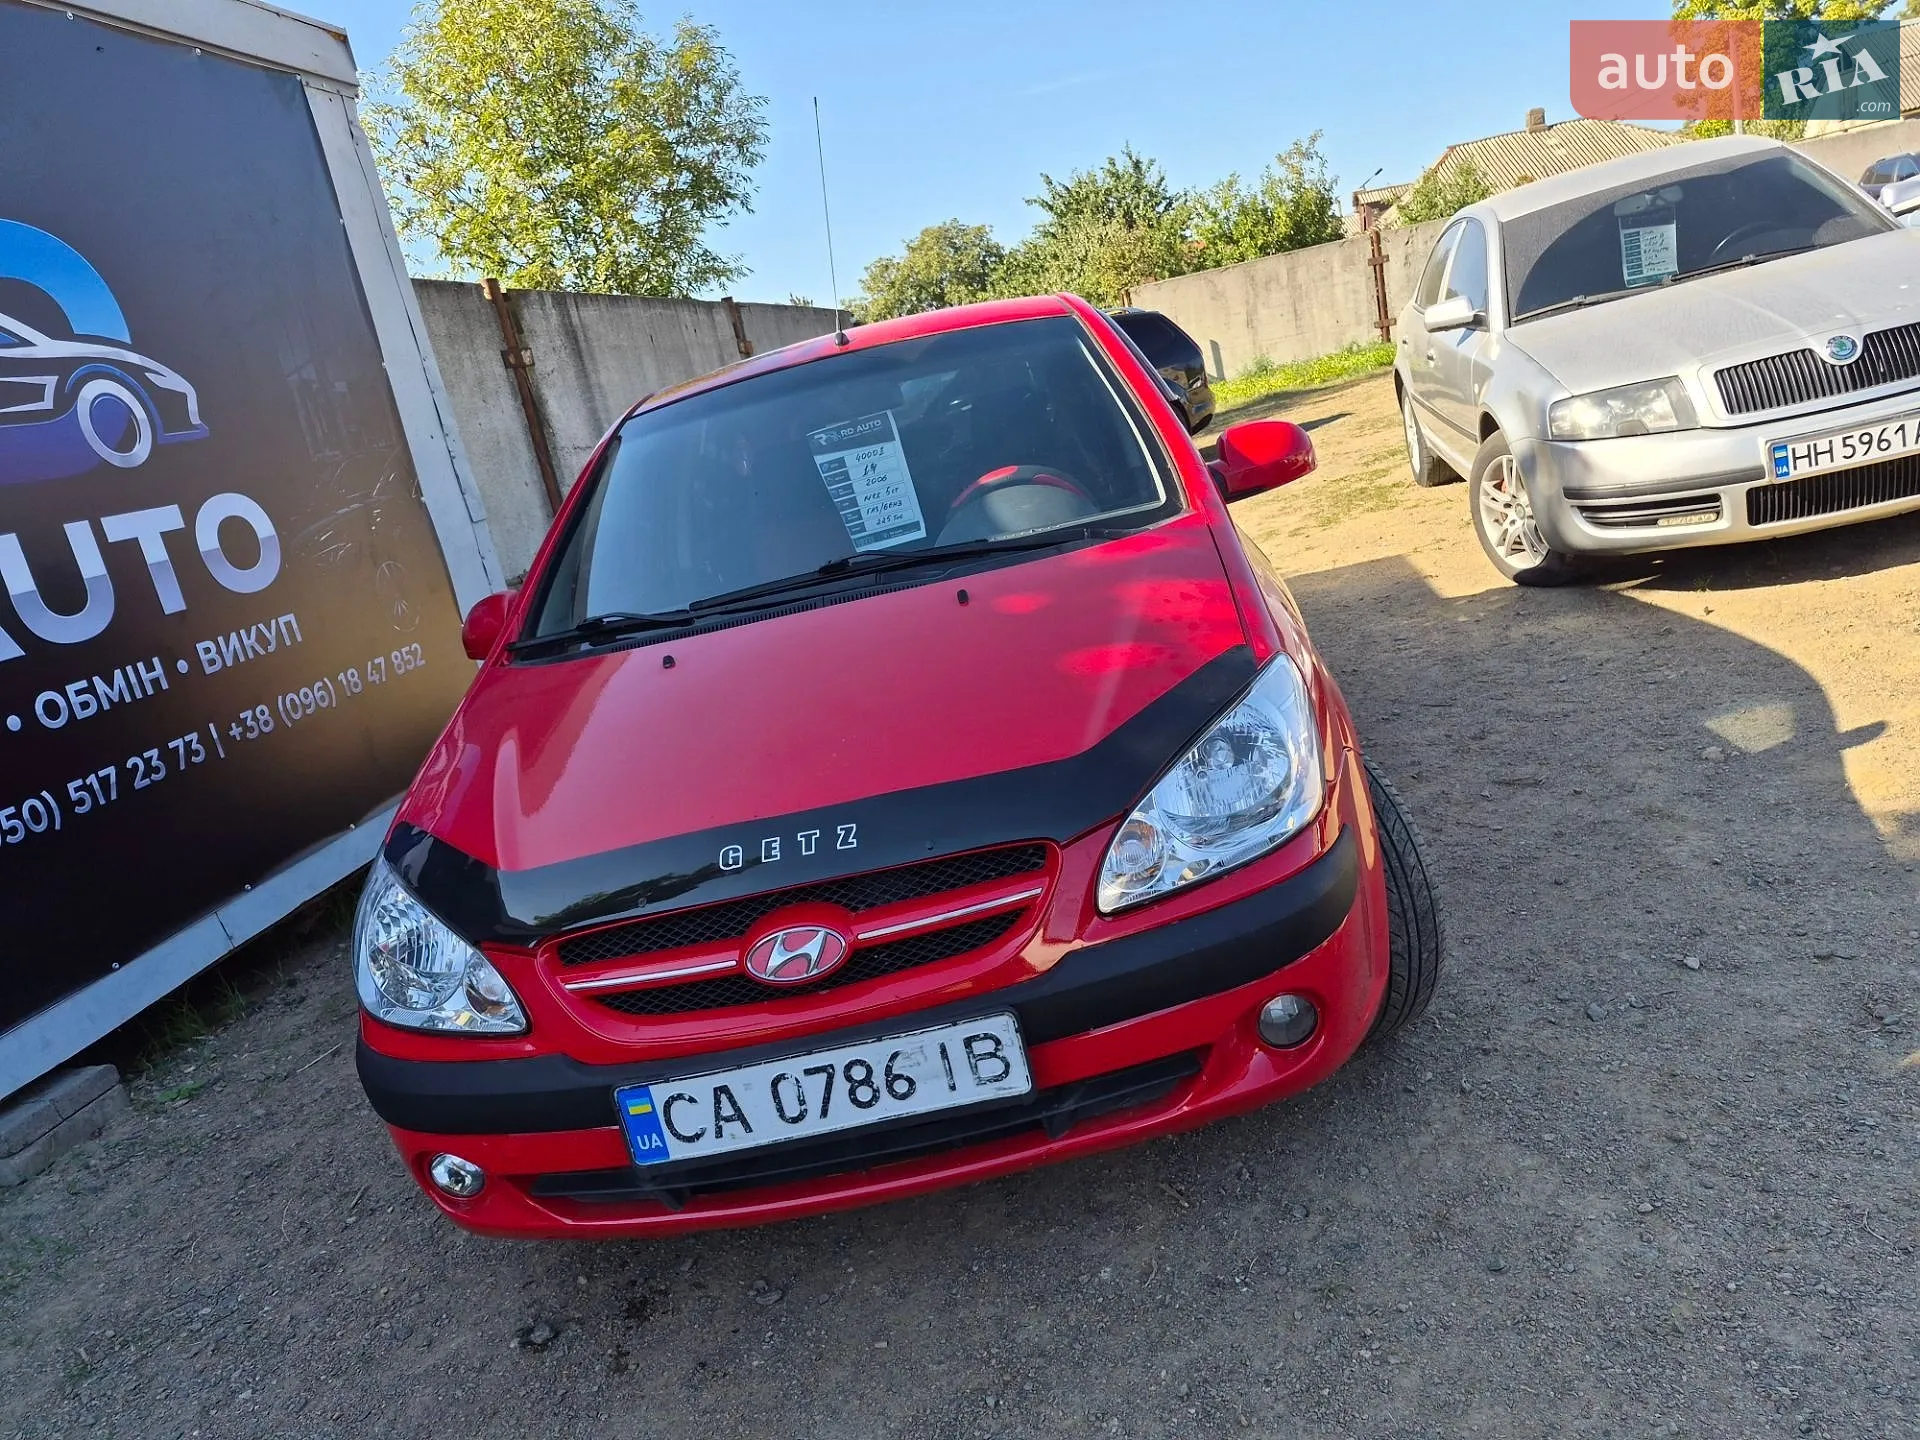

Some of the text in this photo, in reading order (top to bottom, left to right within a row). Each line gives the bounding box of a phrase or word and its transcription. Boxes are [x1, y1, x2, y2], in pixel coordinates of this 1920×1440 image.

[840, 427, 855, 438] RD
[857, 419, 881, 433] AUTO
[1791, 439, 1835, 471] HH
[1841, 423, 1907, 460] 5961
[865, 474, 888, 487] 2006
[1775, 465, 1789, 475] UA
[34, 613, 303, 730] ОБМІН ВИКУП
[0, 642, 426, 848] 50) 517 23 73 +38 (096) 18 47 852
[719, 823, 857, 871] GETZ
[662, 1031, 1012, 1144] CA 0786 IB
[636, 1132, 664, 1150] UA
